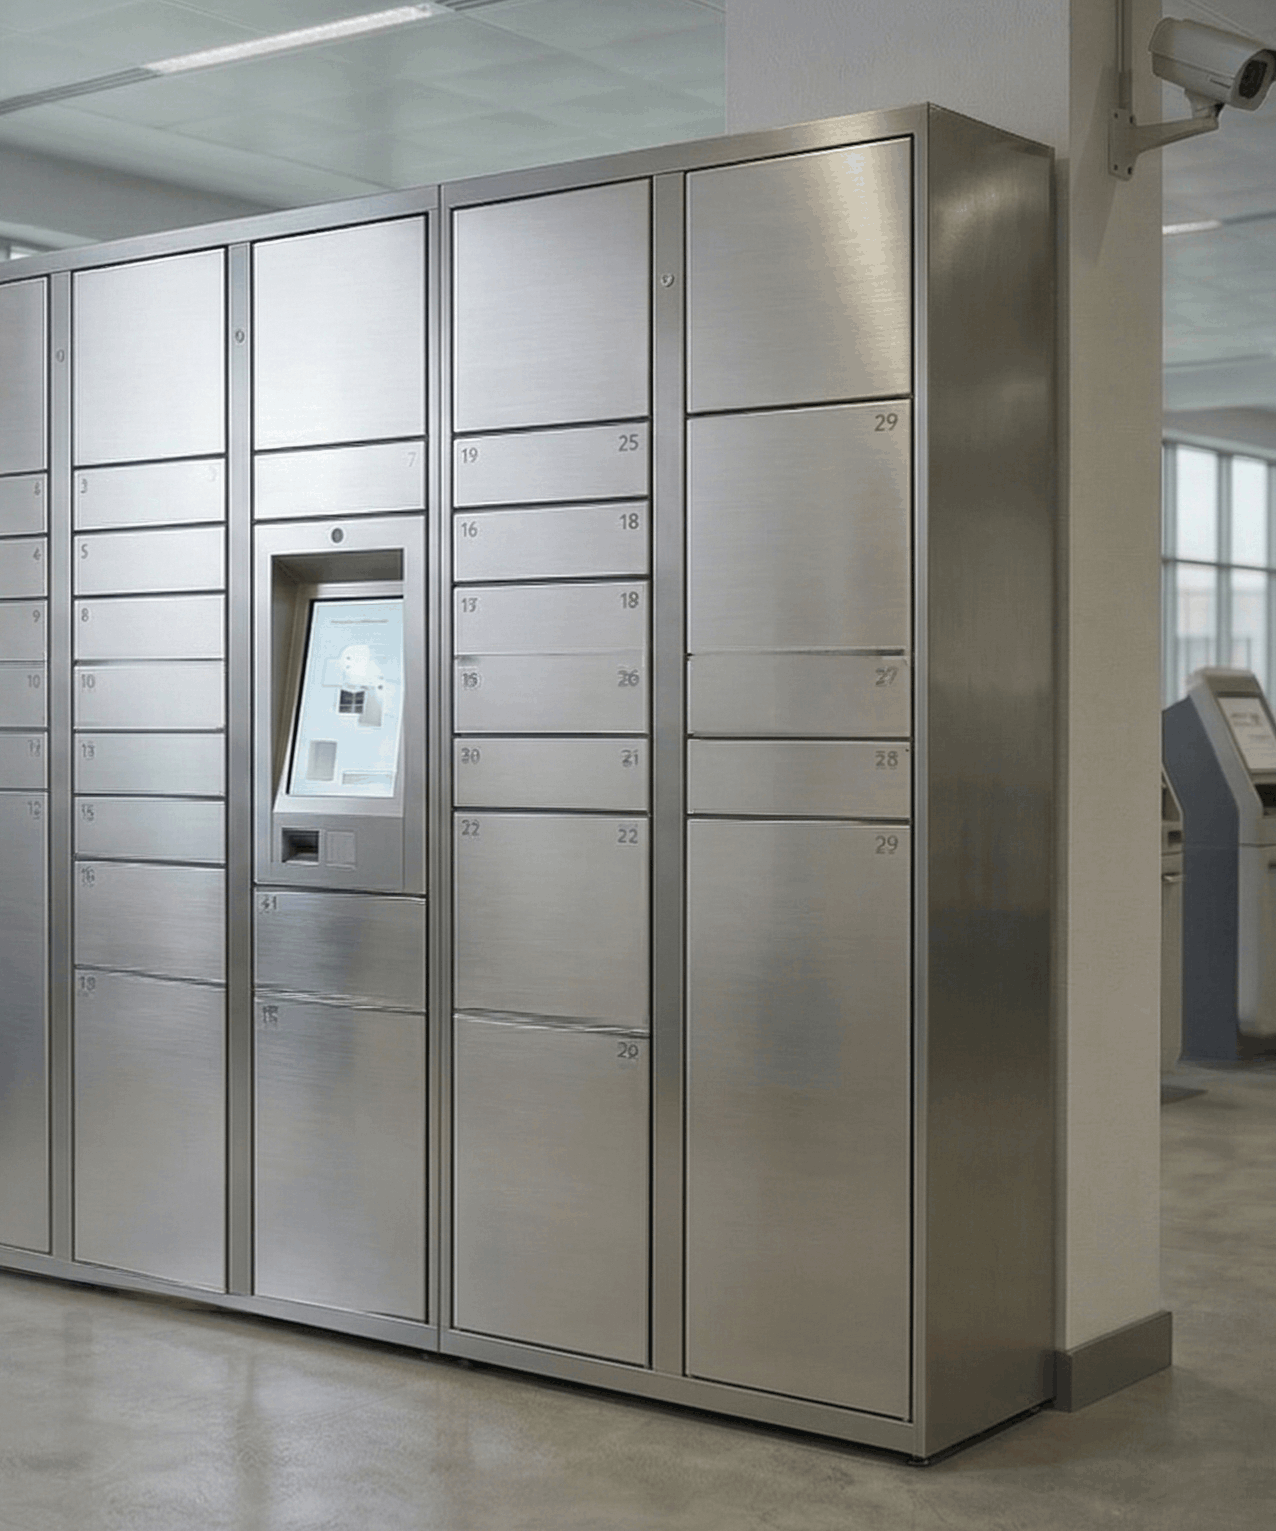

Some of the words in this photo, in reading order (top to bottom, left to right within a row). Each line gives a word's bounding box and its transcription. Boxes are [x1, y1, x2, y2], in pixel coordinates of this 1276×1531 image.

[874, 412, 898, 432] 29
[618, 434, 640, 452] 25
[461, 446, 478, 464] 19
[461, 520, 478, 538] 16
[619, 512, 640, 530] 18
[620, 590, 640, 610] 18
[81, 608, 89, 623] 8
[27, 674, 41, 689] 10
[875, 750, 899, 768] 28
[617, 828, 638, 844] 22
[875, 834, 899, 855] 29
